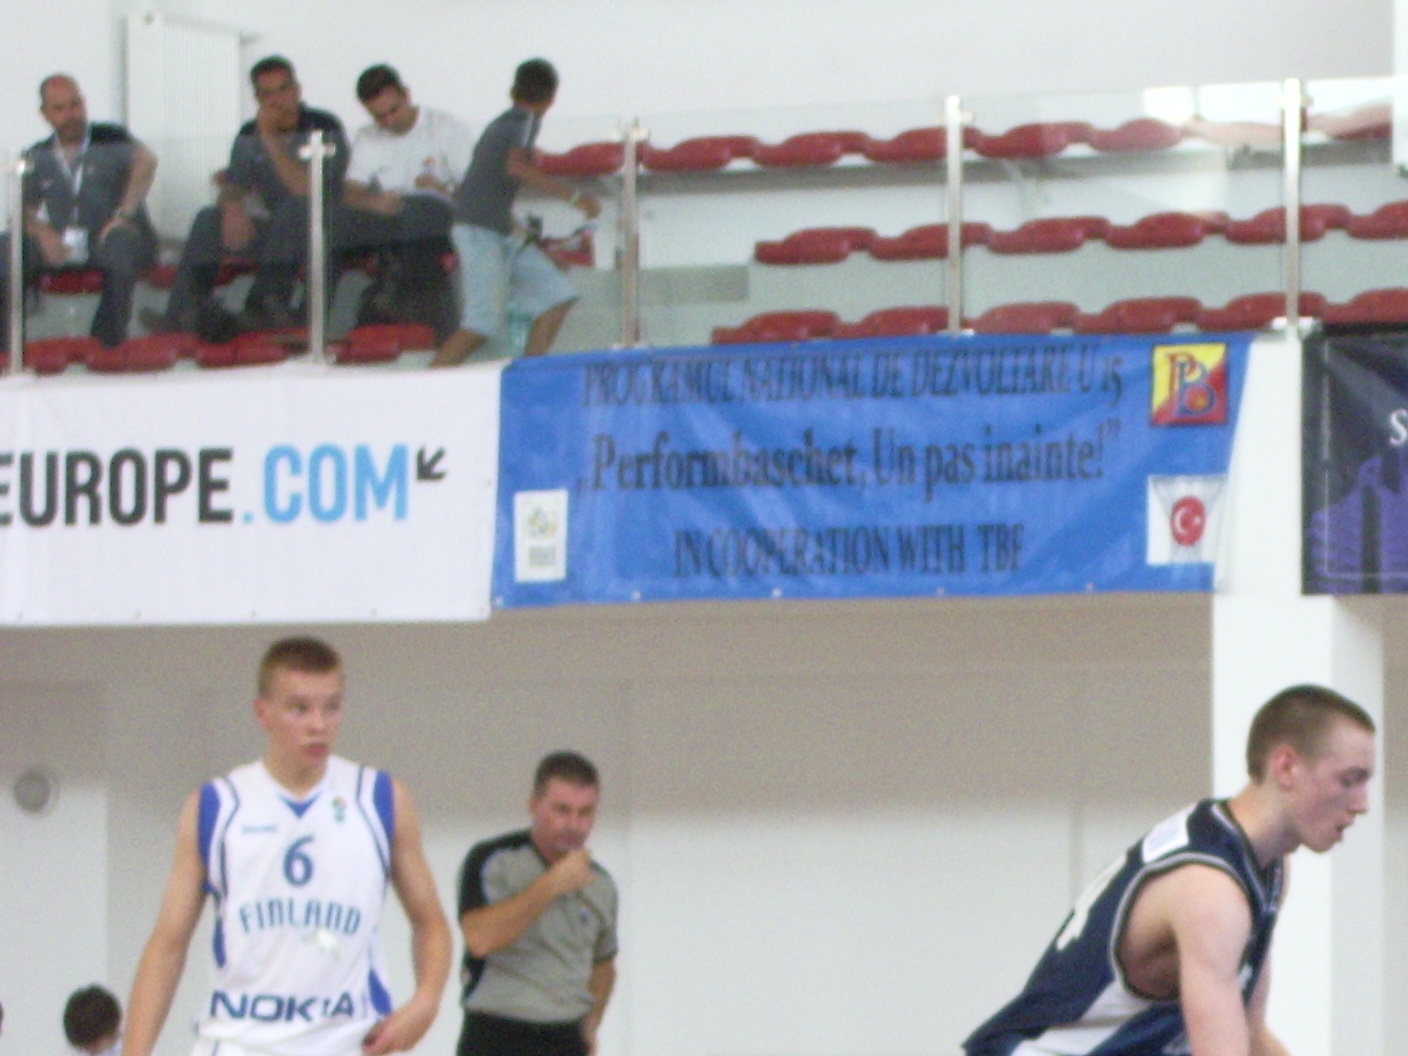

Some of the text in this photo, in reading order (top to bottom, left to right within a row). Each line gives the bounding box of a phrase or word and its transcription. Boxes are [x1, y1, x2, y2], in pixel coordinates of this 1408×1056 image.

[924, 441, 976, 507] pas
[896, 522, 965, 574] WITH
[282, 834, 317, 887] 6
[238, 897, 363, 935] FINLAND
[209, 990, 356, 1022] NOKIA
